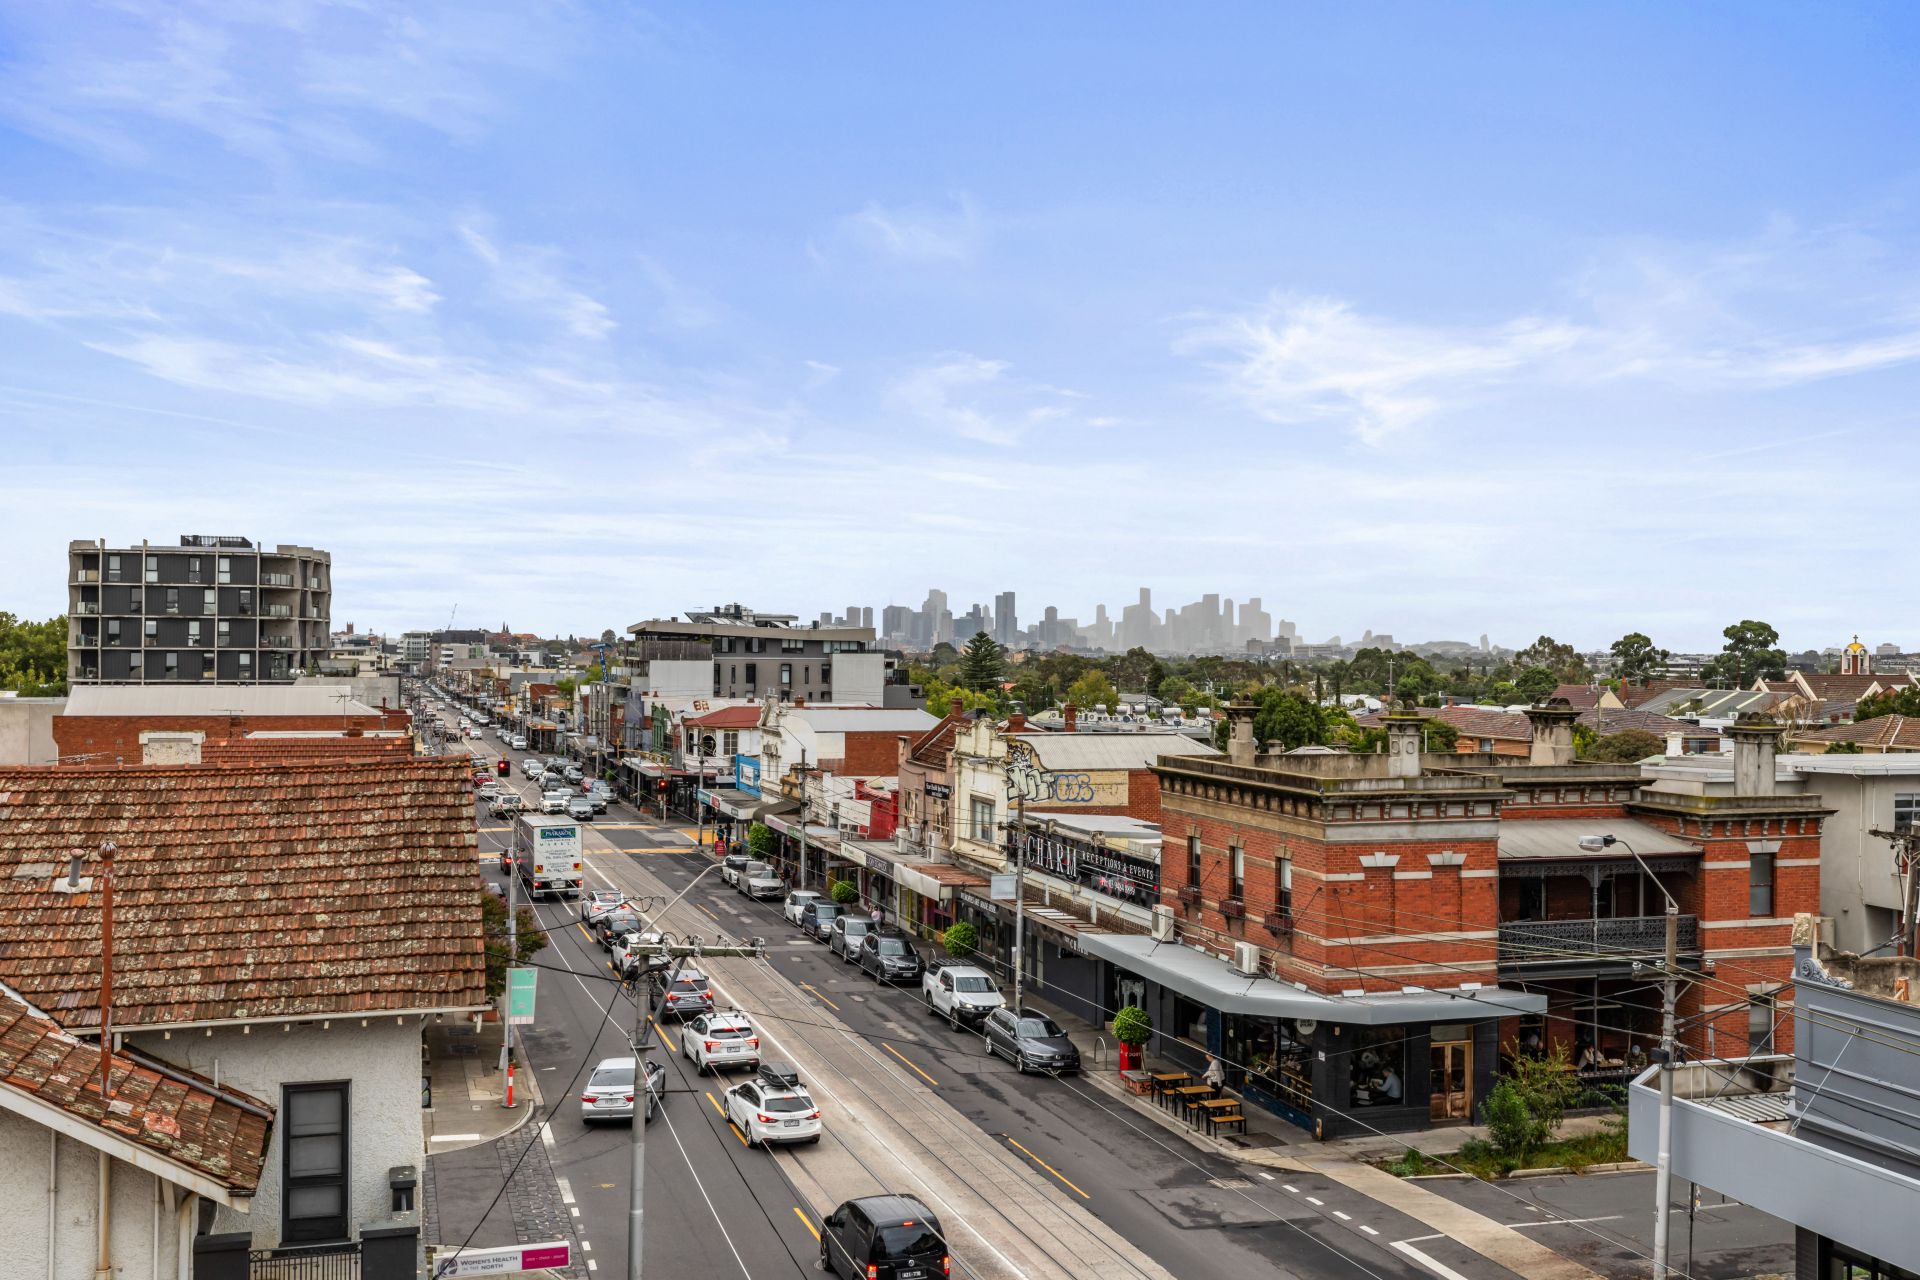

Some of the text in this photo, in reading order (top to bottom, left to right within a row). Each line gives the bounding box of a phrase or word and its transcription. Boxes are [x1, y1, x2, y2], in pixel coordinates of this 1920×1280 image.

[1027, 835, 1077, 878] CHARM
[1082, 850, 1121, 871] RECEPTIONS
[1129, 864, 1154, 880] EVENTS
[460, 1258, 491, 1266] WOMEN'S
[492, 1255, 518, 1263] HEALTH
